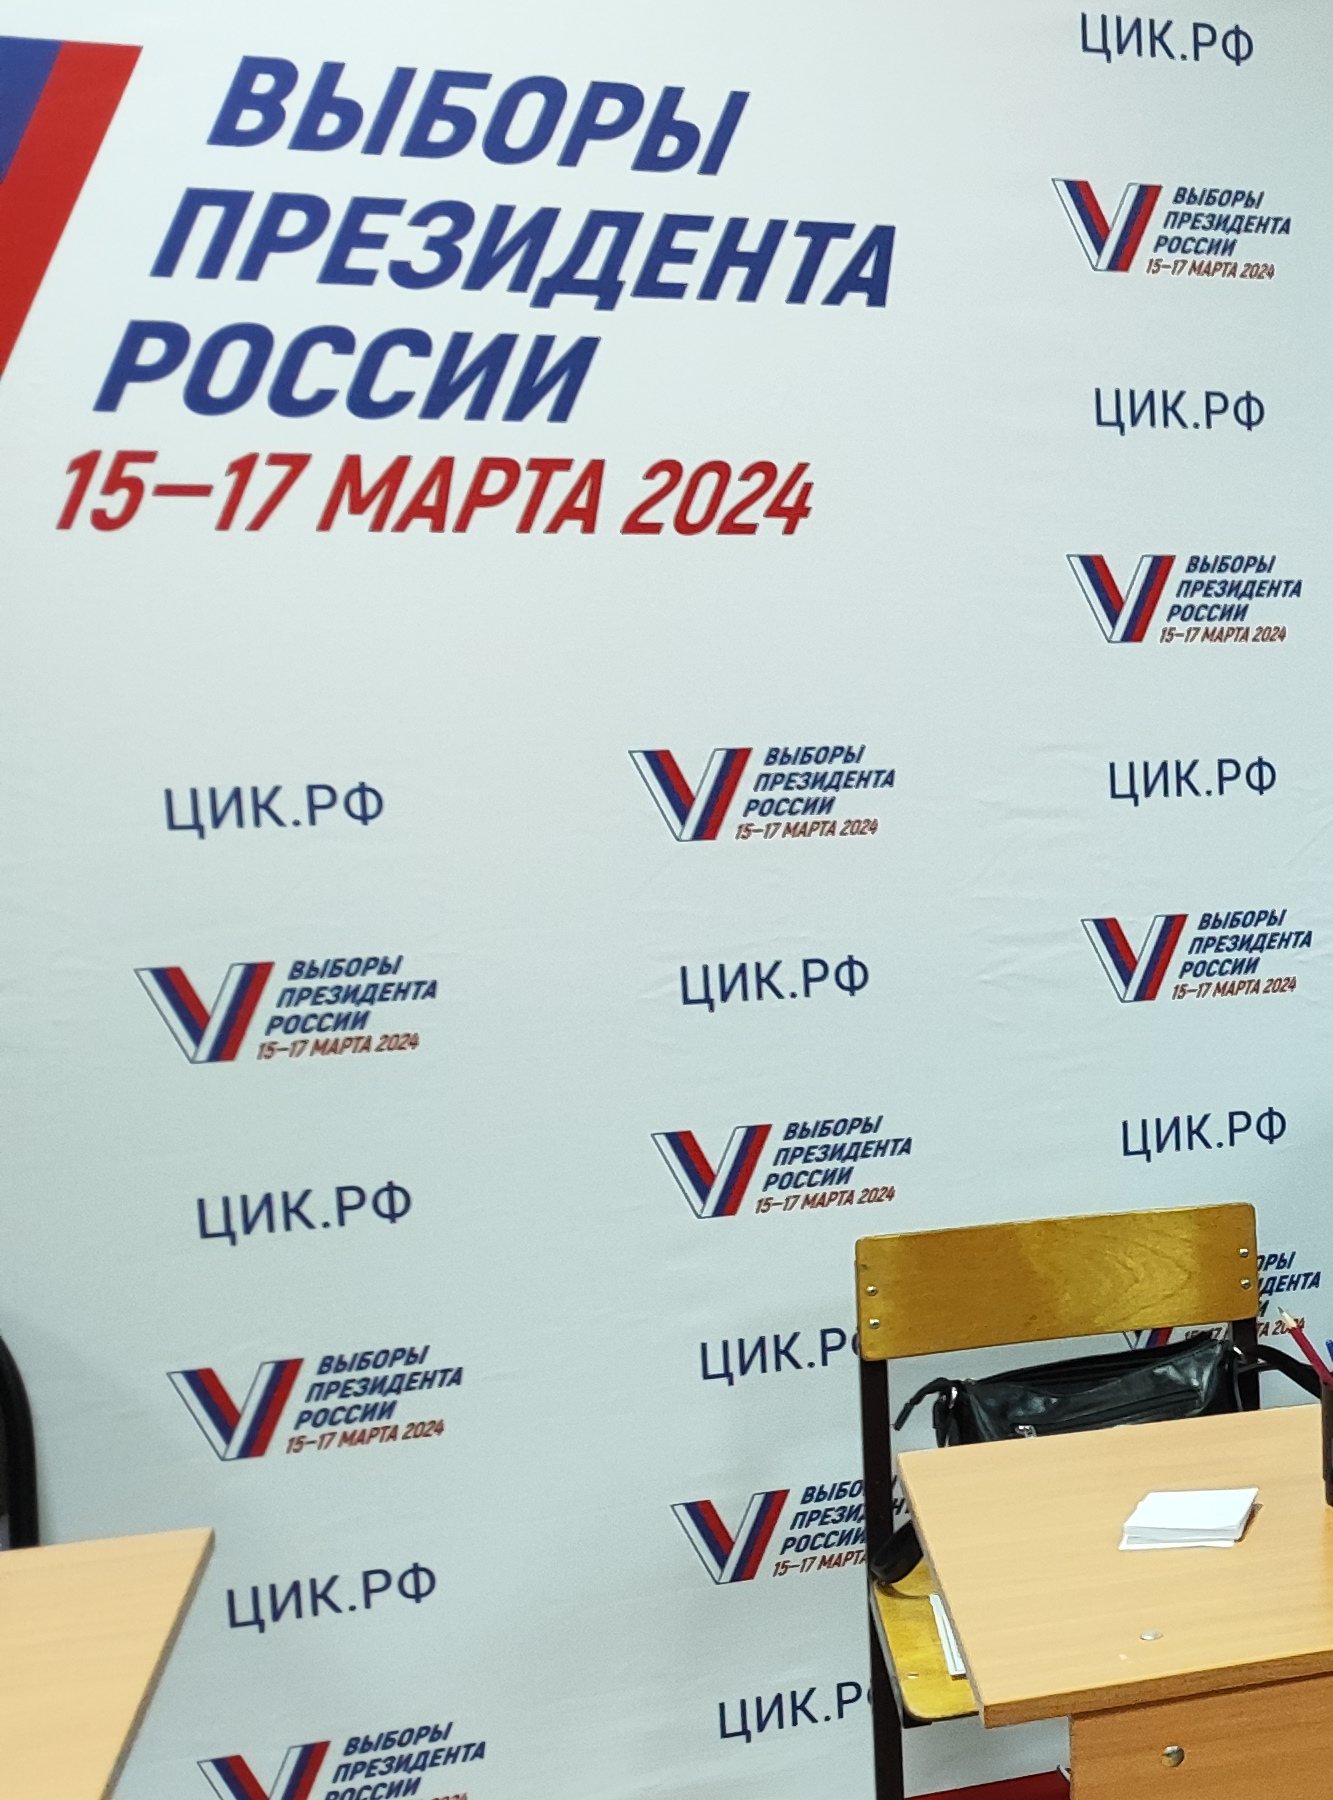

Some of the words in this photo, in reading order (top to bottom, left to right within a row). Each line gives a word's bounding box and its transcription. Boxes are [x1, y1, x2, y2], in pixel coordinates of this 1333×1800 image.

[1081, 12, 1253, 67] ЦИК.РФ
[206, 55, 751, 176] ВЫБОРЫ
[1172, 186, 1265, 209] ВЫБОРЫ
[1162, 211, 1291, 235] ПРЕЗИДЕНТА
[149, 187, 896, 308] ПРЕЗИДЕНТА
[1153, 235, 1238, 257] РОССИИ
[1188, 259, 1238, 278] МАРТА
[1240, 263, 1275, 280] 2024
[92, 319, 602, 423] РОССИИ
[1095, 388, 1265, 436] ЦИК.РФ
[316, 454, 606, 534] МАРТА
[620, 459, 811, 536] 2024
[1185, 555, 1276, 574] ВЫБОРЫ
[1176, 579, 1303, 600] ПРЕЗИДЕНТА
[1166, 603, 1249, 623] РОССИИ
[1200, 626, 1250, 643] МАРТА
[1252, 626, 1286, 642] 2024
[763, 744, 866, 766] ВЫБОРЫ
[753, 769, 896, 792] ПРЕЗИДЕНТА
[1109, 756, 1276, 807] ЦИК.РФ
[164, 781, 384, 840] ЦИК.РФ
[742, 796, 836, 817] РОССИИ
[782, 820, 837, 838] МАРТА
[839, 818, 878, 836] 2024
[1197, 909, 1287, 930] ВЫБОРЫ
[1188, 930, 1312, 955] ПРЕЗИДЕНТА
[287, 955, 404, 981] ВЫБОРЫ
[1178, 956, 1261, 979] РОССИИ
[276, 980, 438, 1008] ПРЕЗИДЕНТА
[680, 955, 869, 1013] ЦИК.РФ
[1212, 979, 1261, 998] МАРТА
[1263, 976, 1296, 994] 2024
[264, 1010, 371, 1036] РОССИИ
[309, 1035, 372, 1056] МАРТА
[375, 1033, 419, 1052] 2024
[782, 1115, 884, 1141] ВЫБОРЫ
[1122, 1107, 1286, 1163] ЦИК.РФ
[772, 1137, 912, 1166] ПРЕЗИДЕНТА
[762, 1166, 855, 1192] РОССИИ
[800, 1190, 855, 1210] МАРТА
[856, 1186, 895, 1204] 2024
[197, 1180, 412, 1247] ЦИК.РФ
[316, 1345, 430, 1375] ВЫБОРЫ
[701, 1328, 861, 1387] ЦИК.Р
[304, 1367, 464, 1403] ПРЕЗИДЕНТА
[293, 1400, 398, 1431] РОССИИ
[337, 1424, 399, 1448] МАРТА
[403, 1419, 444, 1440] 2024
[800, 1479, 866, 1505] ВЫБО
[226, 1562, 436, 1634] ЦИК.РФ
[719, 1681, 873, 1744] ЦИК.Р
[343, 1721, 453, 1757] ВЫБОРЫ
[332, 1741, 486, 1784] ПРЕЗИДЕНТА
